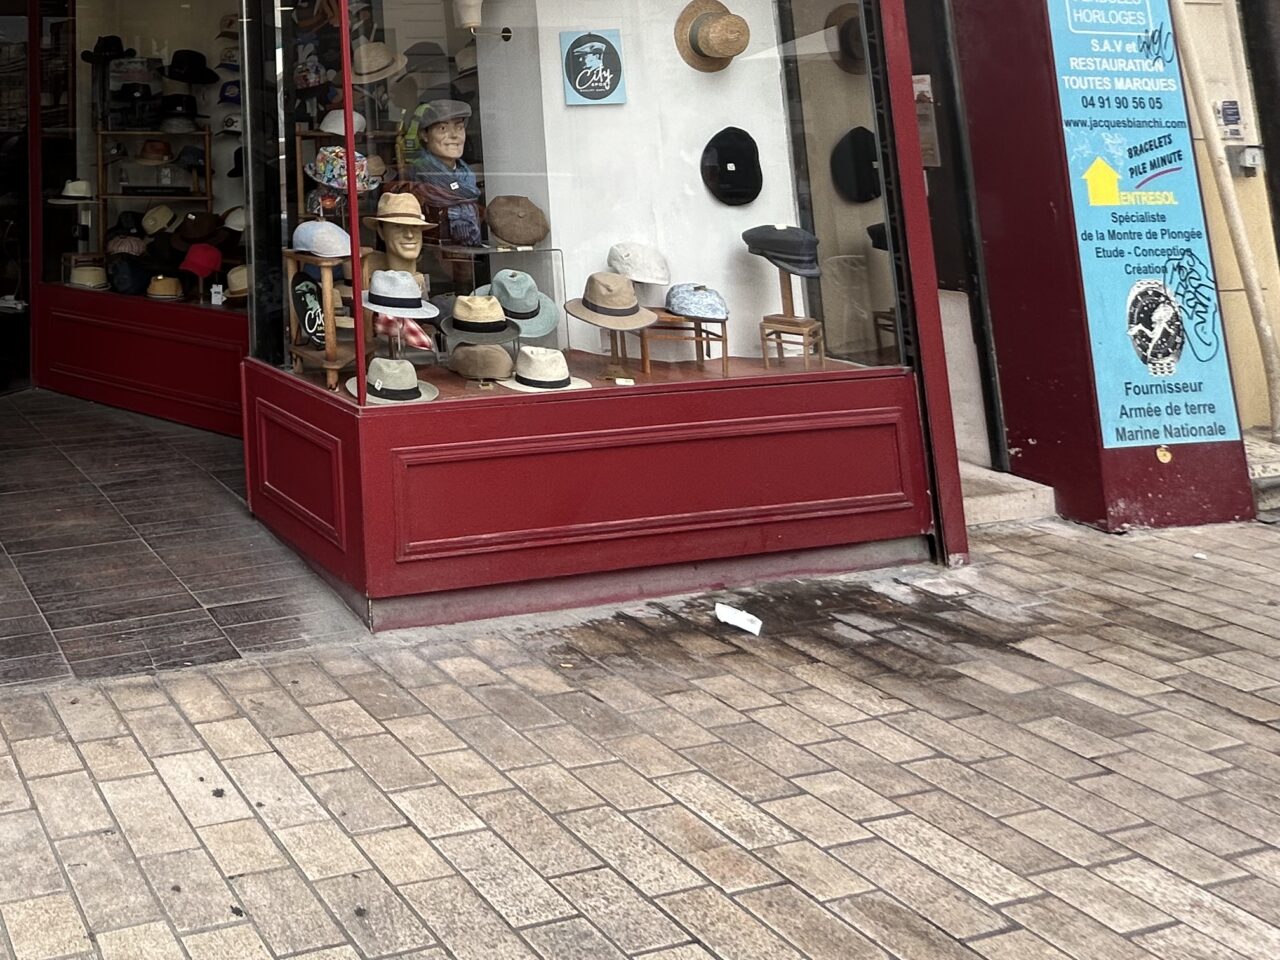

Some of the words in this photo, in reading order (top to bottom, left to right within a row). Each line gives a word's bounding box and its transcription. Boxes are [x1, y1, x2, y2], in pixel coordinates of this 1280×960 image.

[1073, 8, 1146, 25] HORLOGES
[1125, 40, 1138, 52] et
[1069, 57, 1164, 72] RESTAURATION
[576, 65, 614, 90] City
[1062, 76, 1112, 90] TOUTES
[1114, 77, 1177, 91] MARQUES
[1081, 95, 1095, 108] 04
[1097, 96, 1111, 108] 91
[1115, 97, 1129, 109] 90
[1132, 97, 1146, 109] 56
[1149, 97, 1162, 109] 05
[1063, 117, 1186, 130] www.jacquesbianchi.com
[1126, 133, 1172, 159] BRACELETS
[1128, 162, 1147, 178] PILE
[1149, 149, 1183, 171] MINUTE
[1119, 191, 1179, 206] ENTRESOL
[1111, 212, 1166, 225] Spécialiste
[1081, 230, 1093, 241] de
[1095, 229, 1105, 240] la
[1108, 229, 1142, 240] Montre
[1145, 229, 1158, 240] de
[1160, 227, 1203, 242] Plongée
[1095, 246, 1125, 258] Etude
[1124, 263, 1168, 275] Création
[1124, 380, 1203, 396] Fournisseur
[1119, 402, 1161, 419] Armée
[1165, 401, 1181, 416] de
[1184, 402, 1216, 415] terre
[1115, 426, 1160, 442] Marine
[1163, 421, 1226, 439] Nationale
